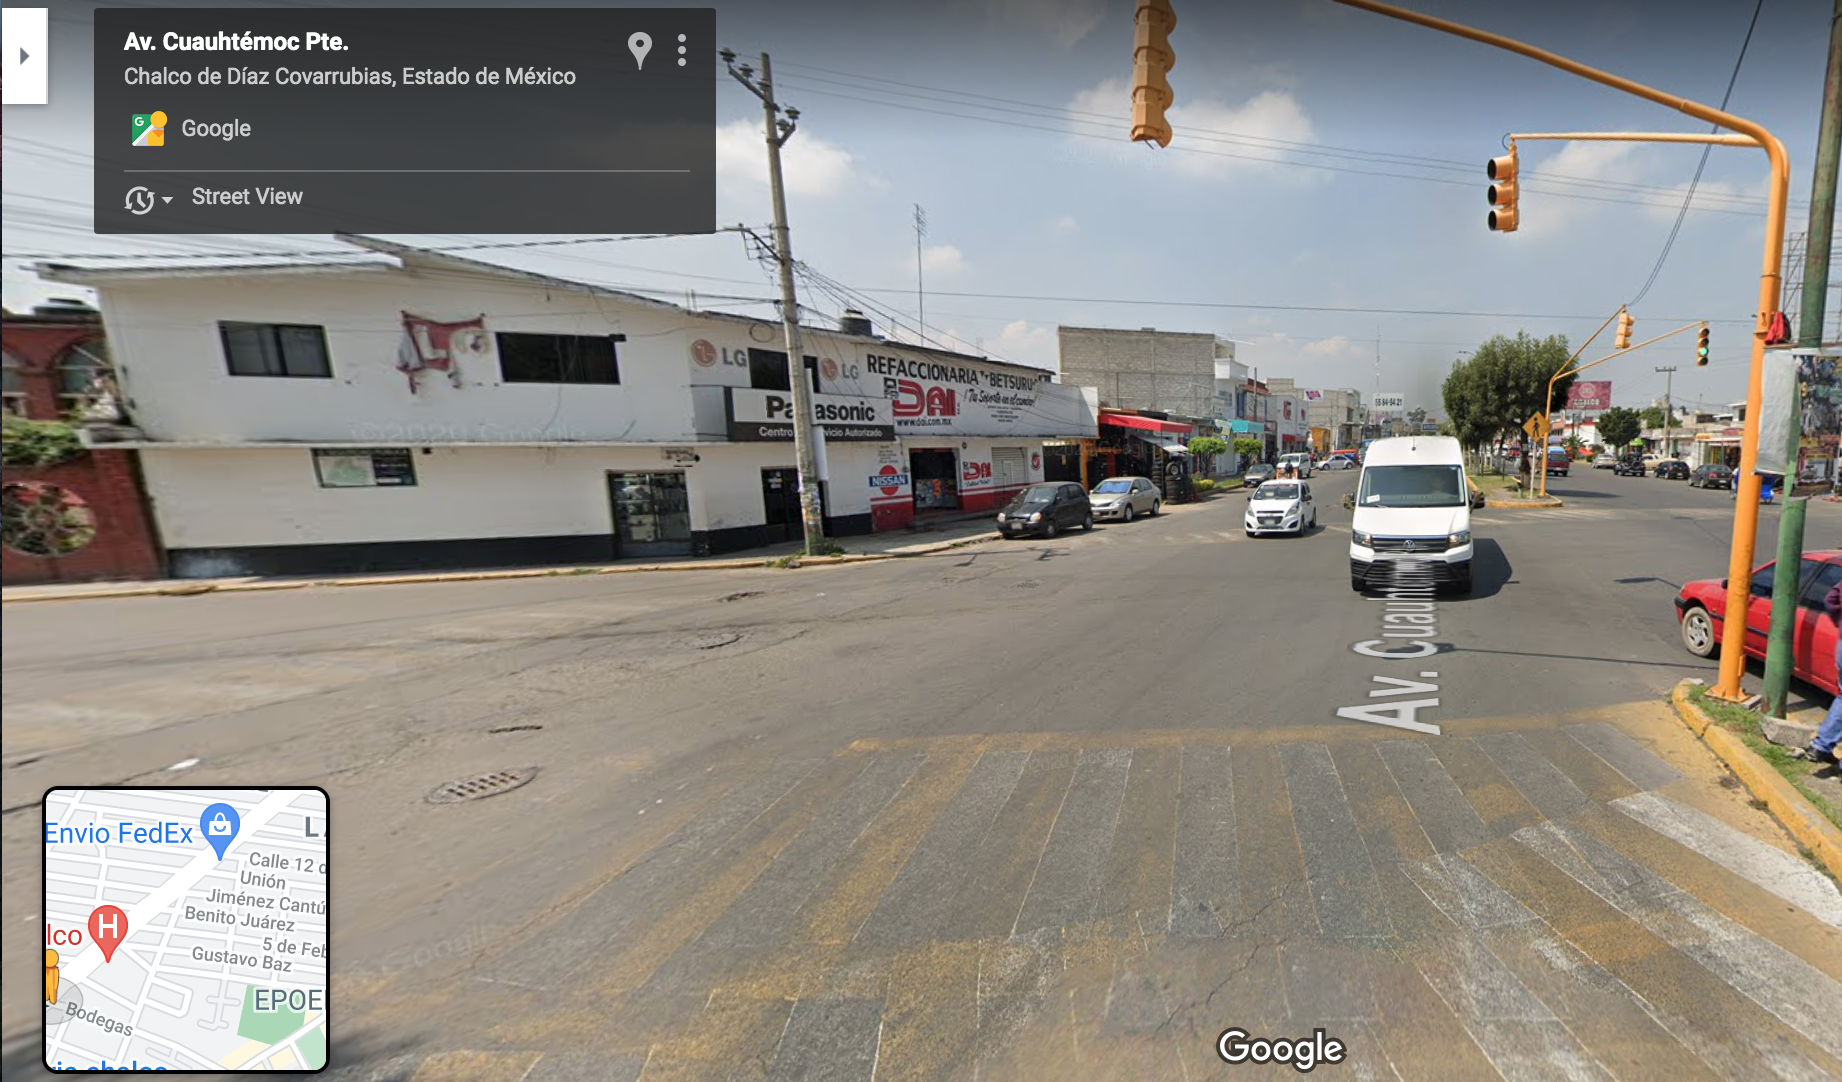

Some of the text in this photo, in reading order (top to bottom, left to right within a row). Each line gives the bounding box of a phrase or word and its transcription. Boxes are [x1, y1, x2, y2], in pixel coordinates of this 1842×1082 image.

[722, 347, 748, 368] LG
[842, 363, 859, 380] LG
[867, 354, 979, 385] REFACCIONARIA
[765, 395, 876, 422] Paasonic
[896, 417, 952, 427] www.dai.com.mx
[759, 426, 794, 438] Centro
[845, 428, 883, 438] Autorizado
[871, 475, 907, 486] NISSAN
